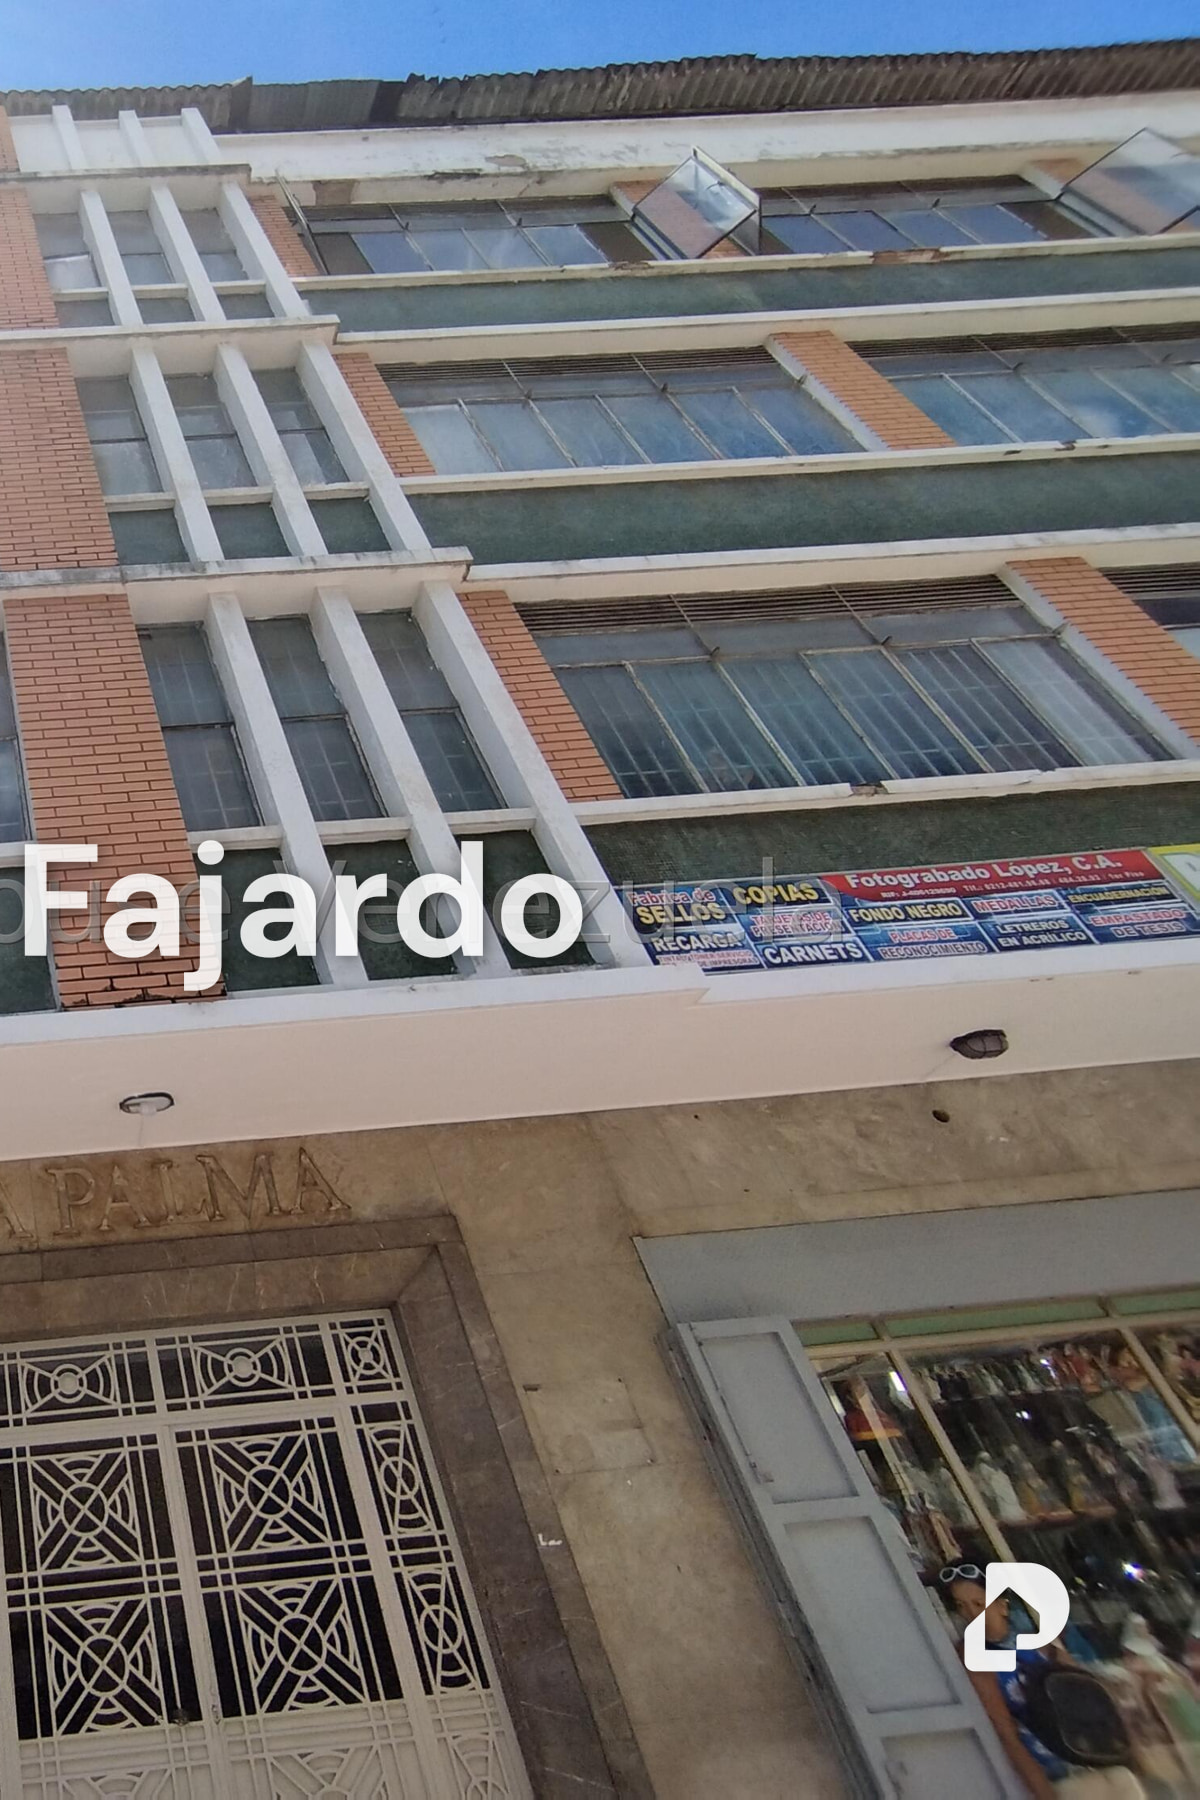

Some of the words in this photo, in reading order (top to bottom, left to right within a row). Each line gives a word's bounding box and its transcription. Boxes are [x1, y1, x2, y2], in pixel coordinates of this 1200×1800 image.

[845, 866, 991, 889] Fotograbado
[992, 857, 1072, 879] López,
[1071, 853, 1123, 871] C.A.
[692, 887, 715, 903] de
[732, 882, 819, 905] COPIAS
[848, 906, 905, 923] FONDO
[905, 902, 963, 919] NEGRO
[972, 894, 1058, 913] MEDALLAS
[635, 902, 726, 925] SELLOS
[812, 910, 832, 921] DE
[1090, 908, 1186, 926] EMPASTADO
[888, 928, 939, 943] PLACAS
[939, 927, 957, 940] DE
[995, 919, 1070, 934] LETREROS
[1111, 926, 1138, 937] DE
[1135, 921, 1186, 936] TESIS
[652, 932, 744, 952] RECARGA
[877, 940, 988, 960] RECONOCIMIENTO
[997, 936, 1021, 948] EN
[763, 941, 863, 965] CARNETS
[44, 1146, 352, 1237] PALMA
